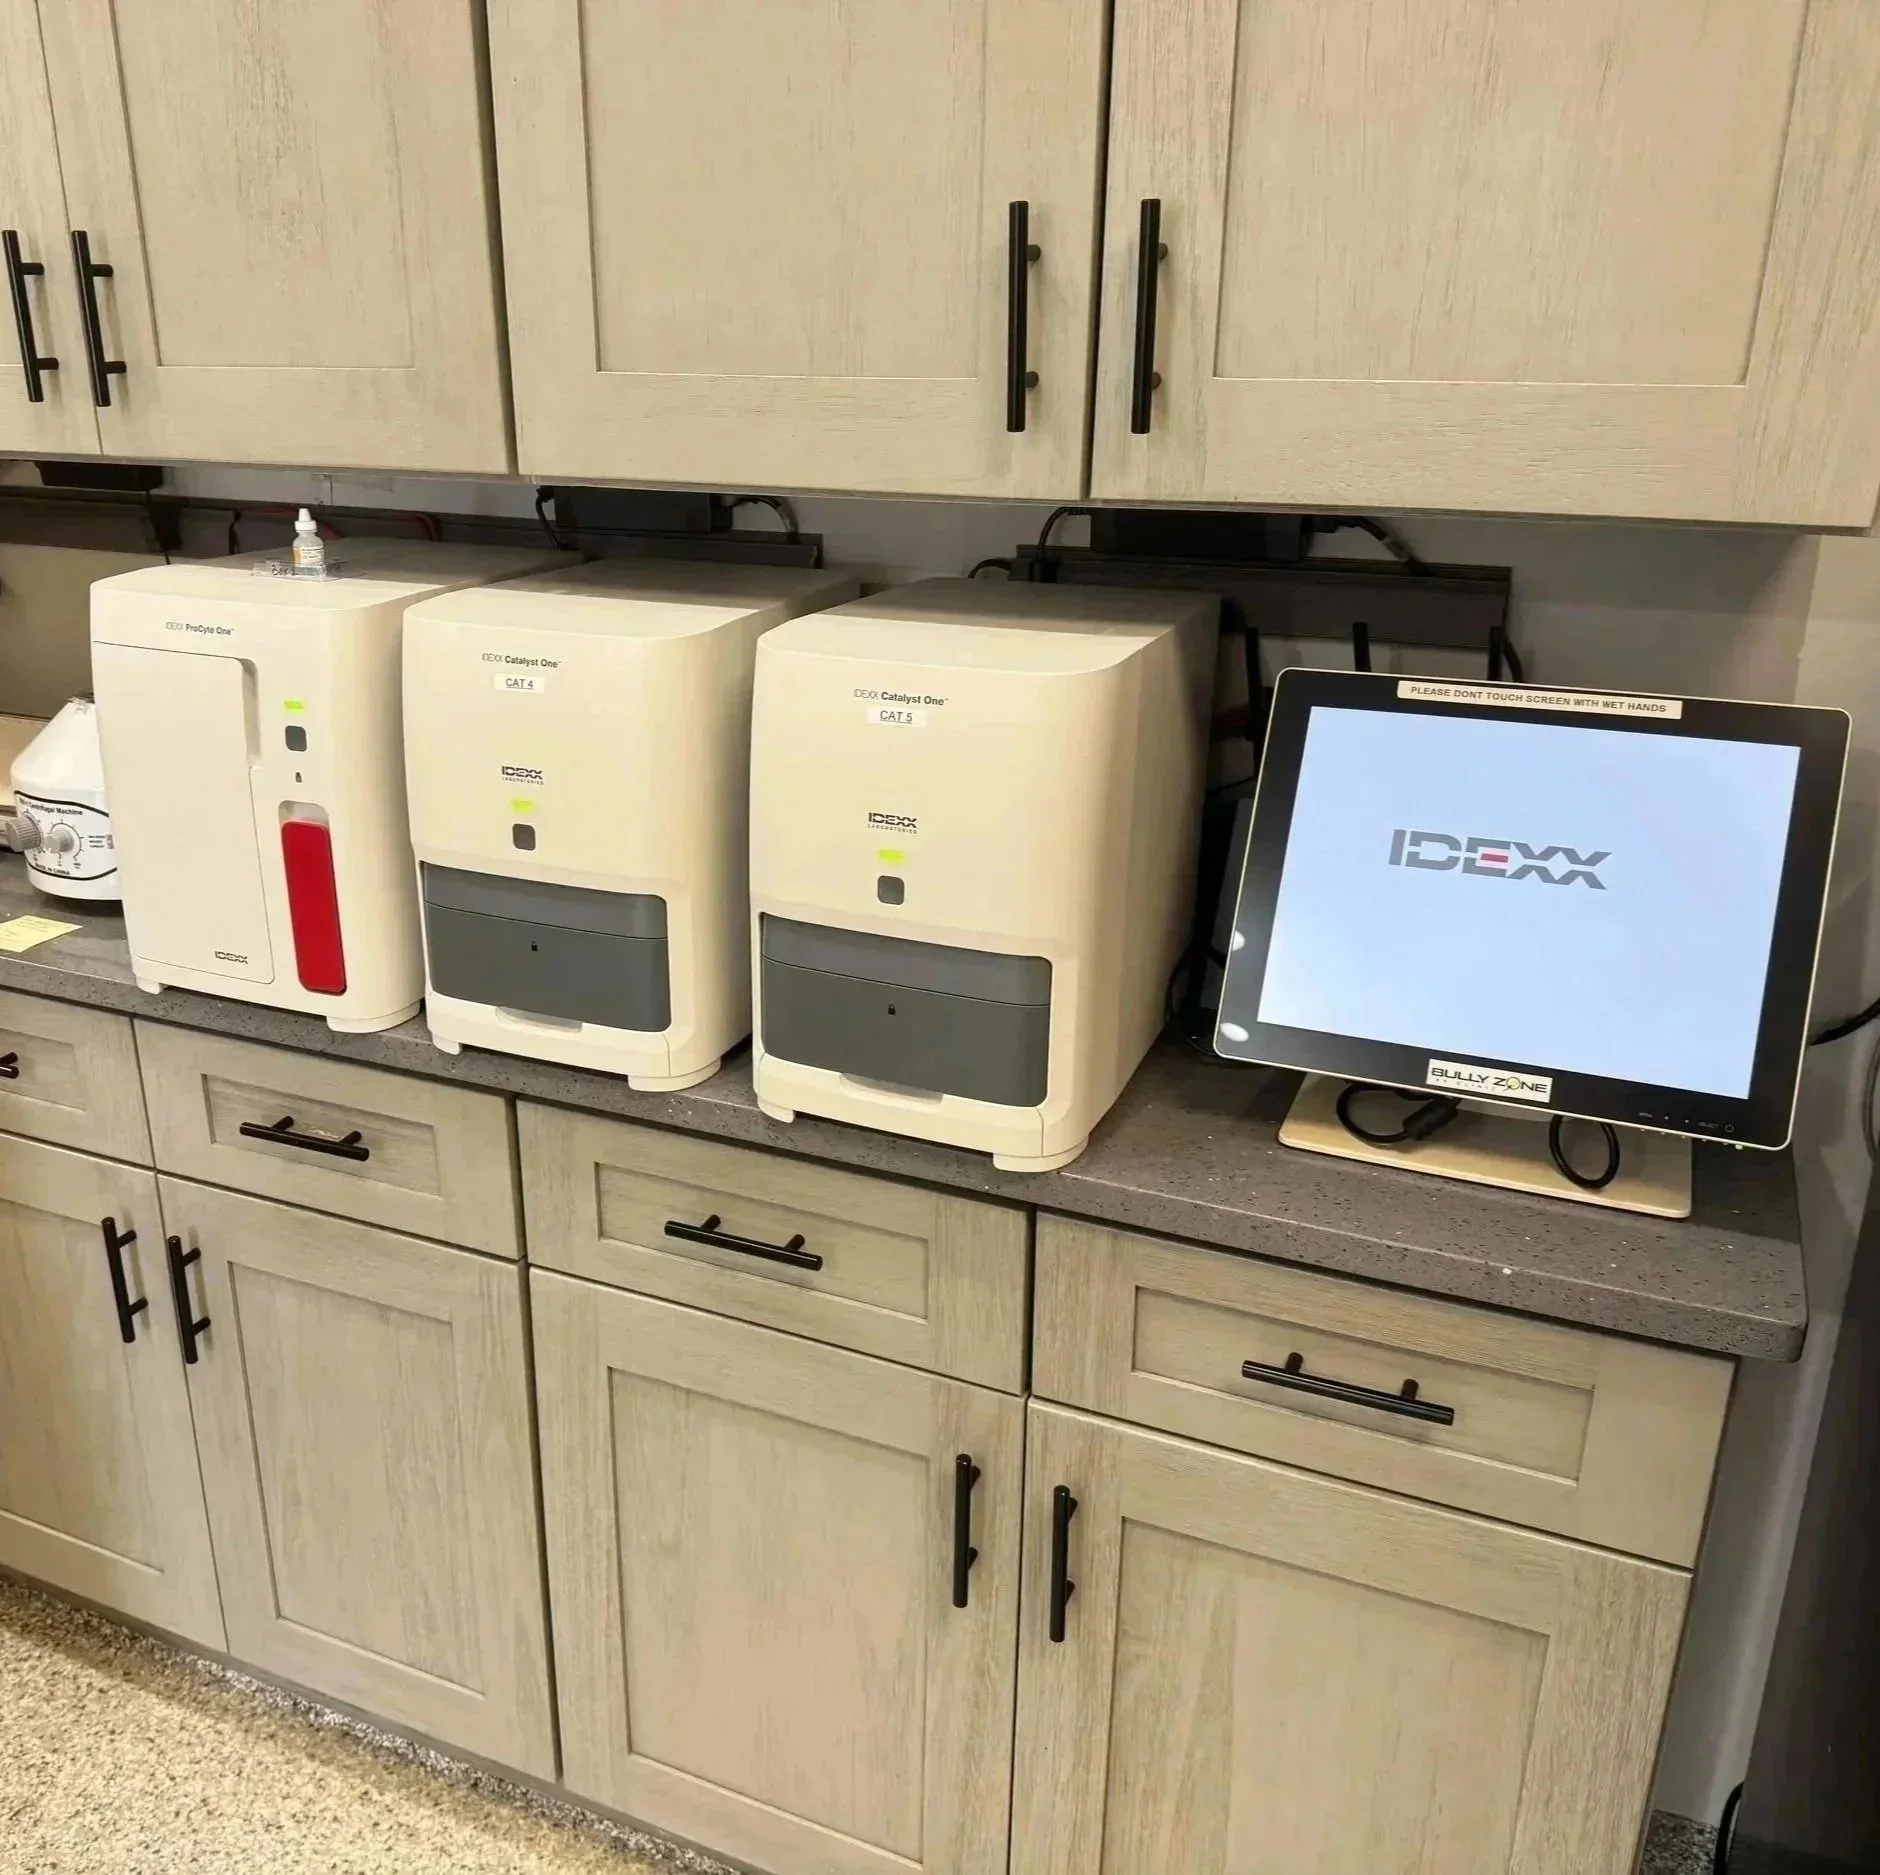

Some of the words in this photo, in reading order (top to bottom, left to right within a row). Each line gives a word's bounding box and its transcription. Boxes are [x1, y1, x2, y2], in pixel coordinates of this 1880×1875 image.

[185, 623, 215, 635] ProCyte
[504, 655, 539, 667] Catalyst
[505, 678, 526, 689] CAT
[527, 680, 534, 689] 4
[881, 691, 922, 705] Catalyst
[1410, 686, 1451, 697] PLEASE
[1453, 689, 1484, 699] DONT
[1486, 692, 1523, 701] TOUCH
[1526, 695, 1571, 706] SCREEN
[1573, 698, 1600, 707] WITH
[1602, 701, 1625, 709] WET
[1627, 702, 1667, 712] HANDS
[879, 710, 903, 722] CAT
[906, 712, 913, 723] 5
[501, 765, 544, 780] IDEXX
[56, 807, 83, 816] Machine
[868, 812, 918, 829] IDEXX
[1388, 829, 1613, 890] IDEXX
[214, 950, 249, 964] IDEXX
[1431, 1067, 1490, 1084] BULLY
[1493, 1076, 1548, 1094] ZONE
